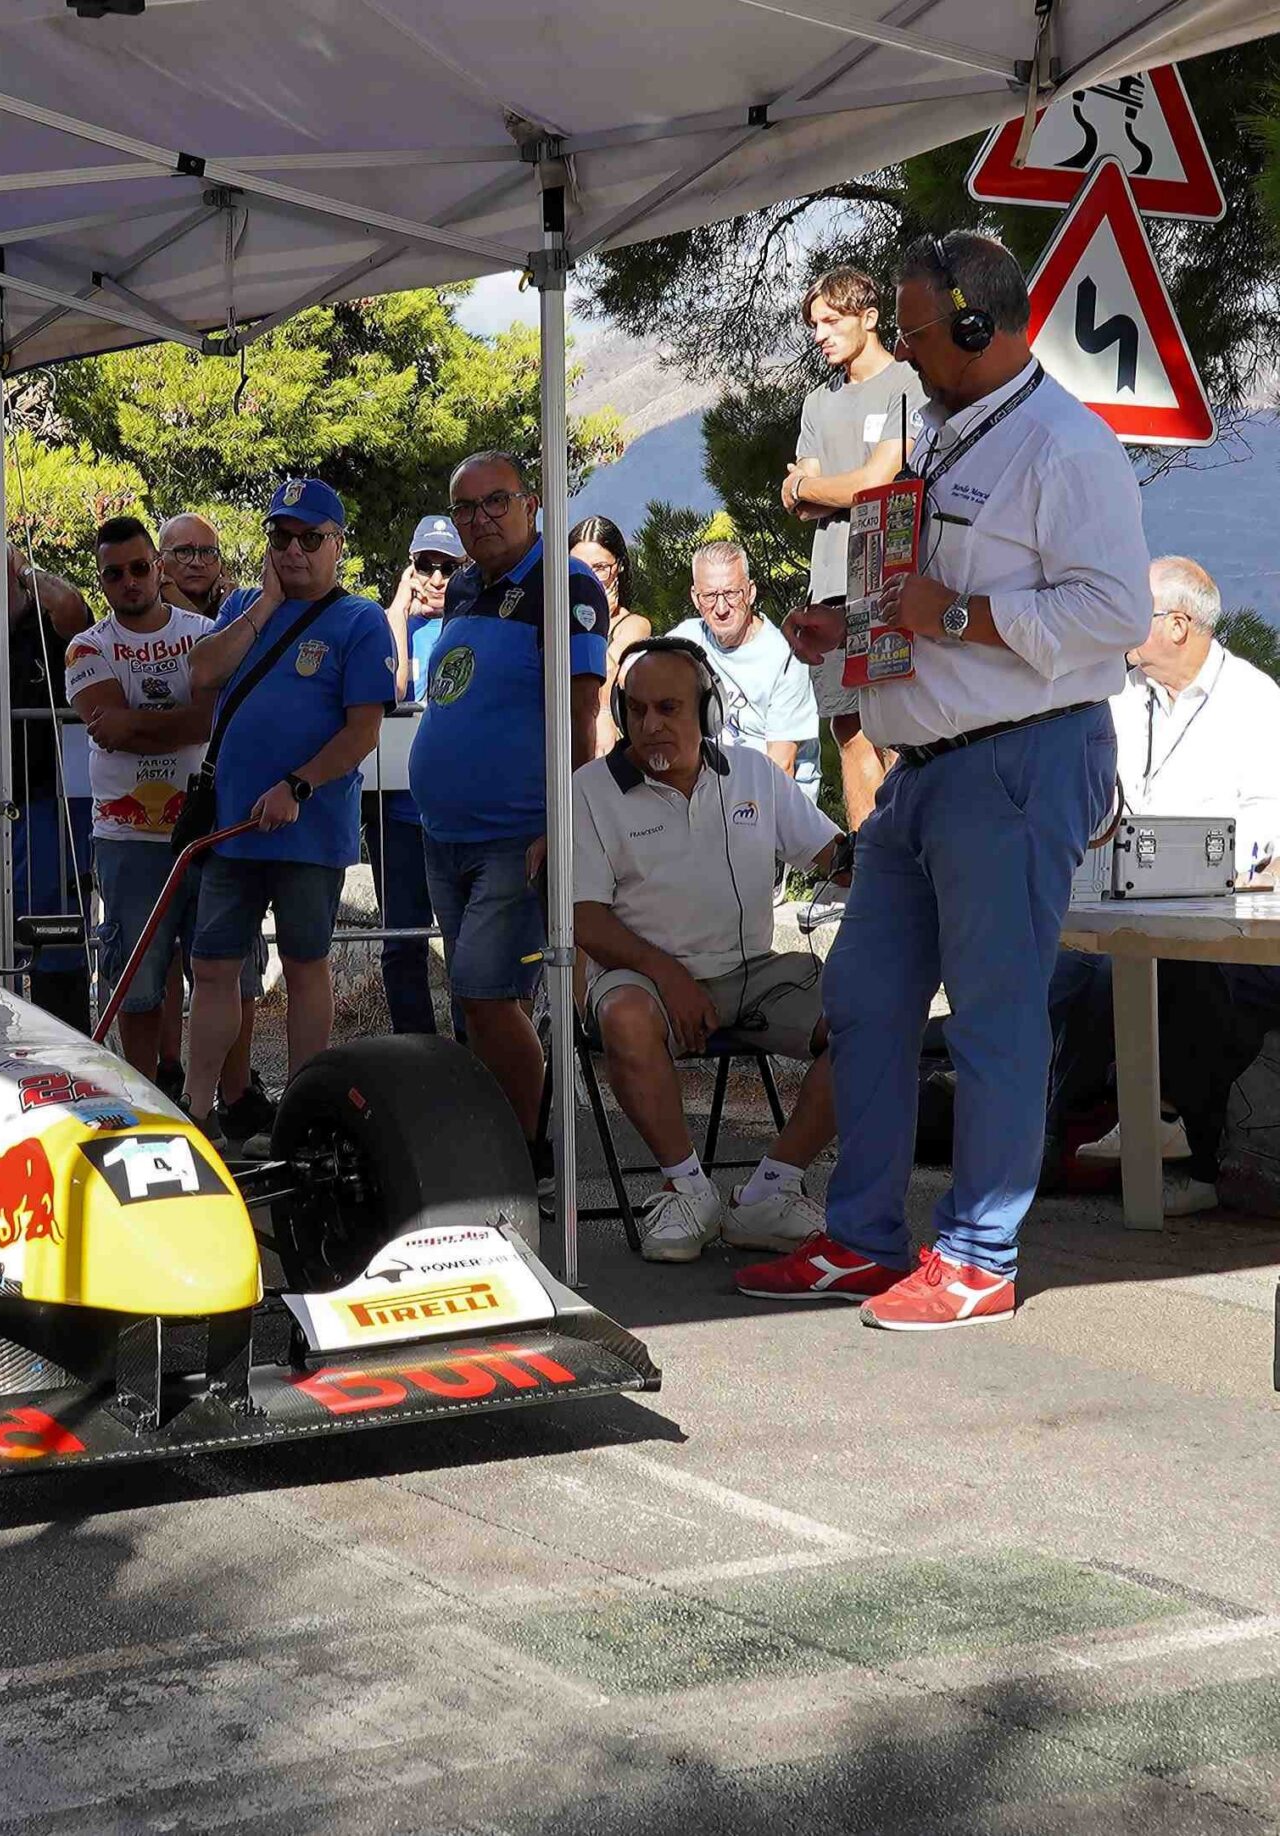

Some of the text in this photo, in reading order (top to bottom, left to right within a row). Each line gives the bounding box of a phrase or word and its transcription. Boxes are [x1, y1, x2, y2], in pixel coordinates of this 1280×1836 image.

[113, 635, 194, 661] Red Bull
[629, 824, 664, 839] FRANCESCO
[348, 1283, 500, 1327] PIRELLI
